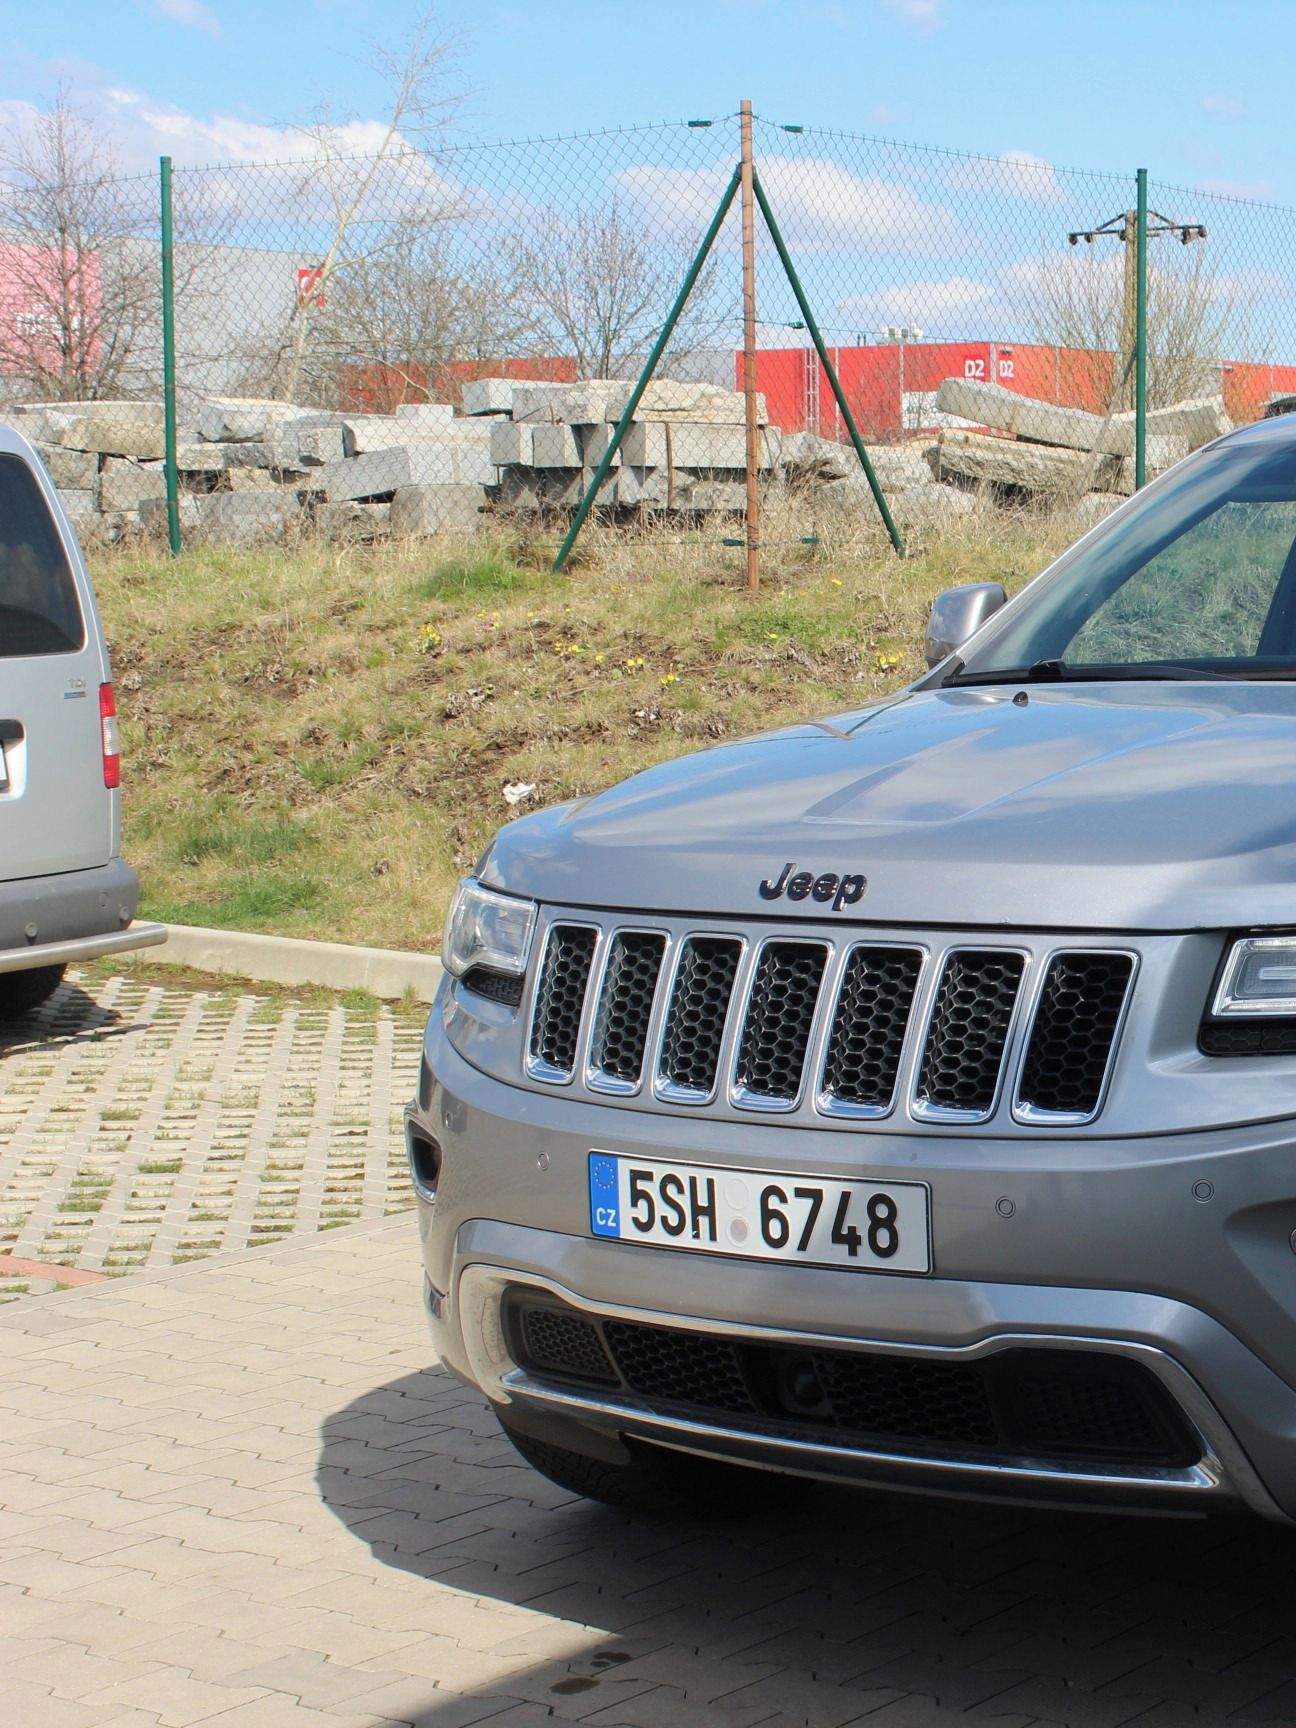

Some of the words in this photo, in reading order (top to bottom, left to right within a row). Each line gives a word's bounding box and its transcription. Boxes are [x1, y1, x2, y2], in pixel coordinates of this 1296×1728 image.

[964, 359, 985, 377] D2
[999, 359, 1015, 378] D2
[759, 862, 868, 911] Jeep
[596, 1207, 617, 1228] CZ
[629, 1168, 718, 1242] 5SH
[760, 1184, 899, 1258] 6748
